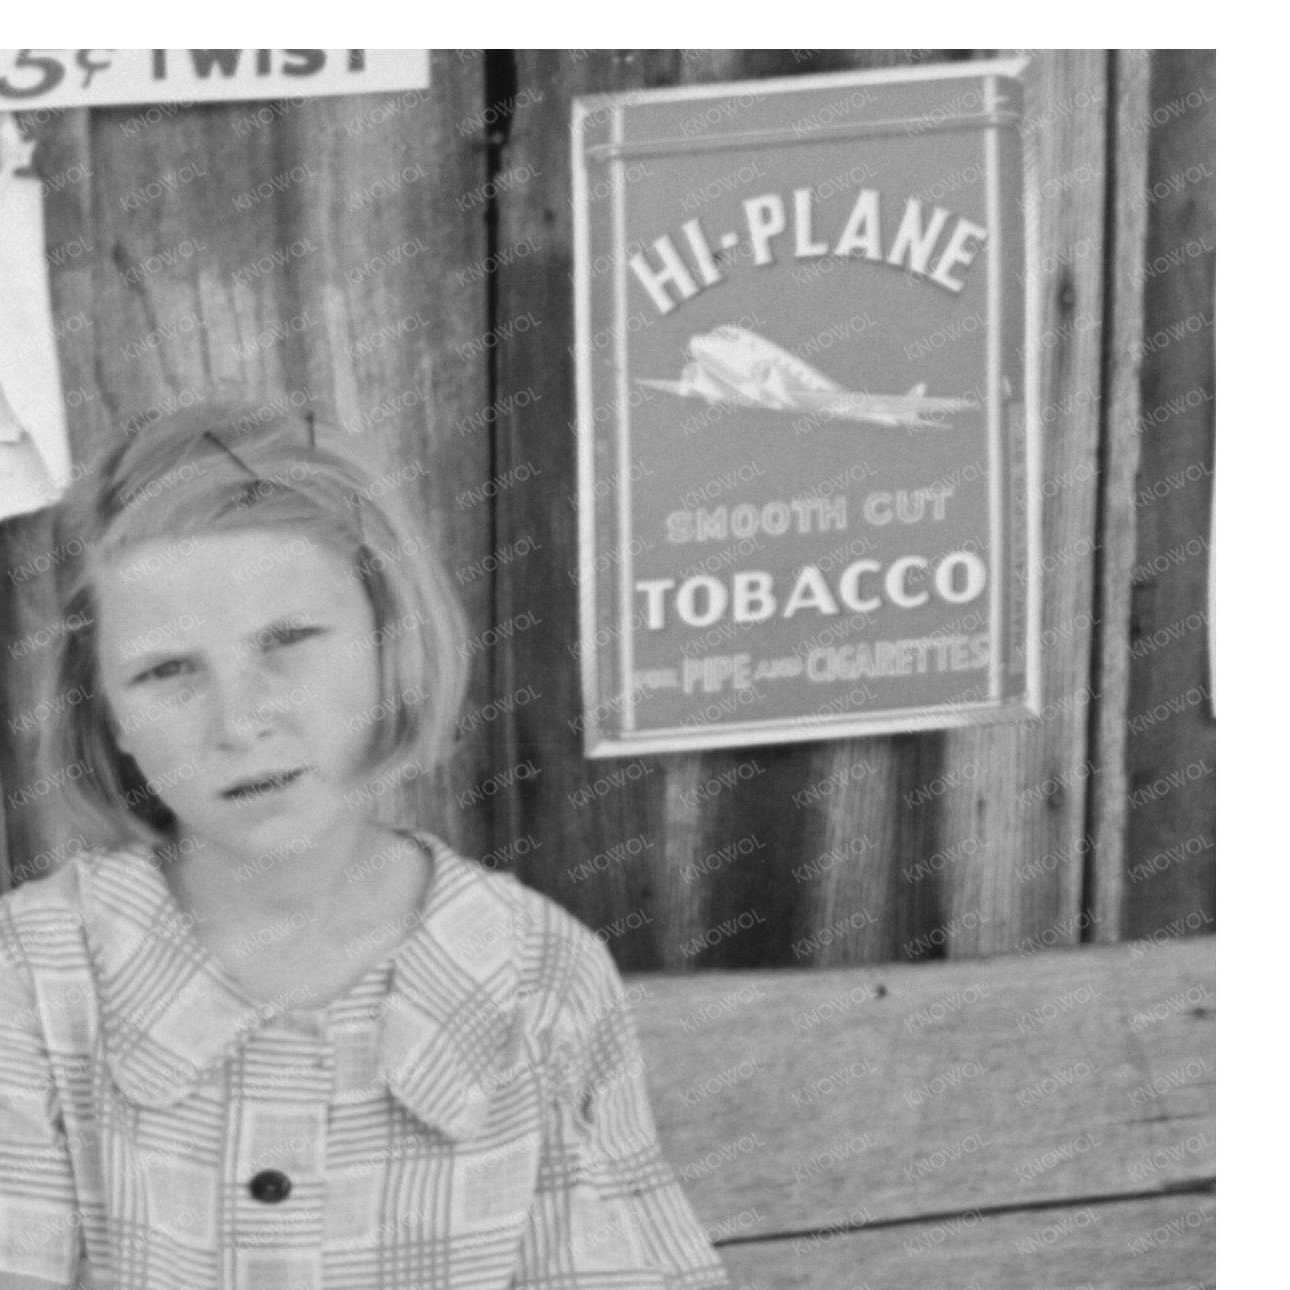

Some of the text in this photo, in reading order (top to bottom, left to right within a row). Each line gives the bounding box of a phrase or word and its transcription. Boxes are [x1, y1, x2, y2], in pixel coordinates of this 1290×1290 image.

[628, 187, 988, 315] HI-PLANE
[666, 487, 954, 543] SMOOTH CUT
[635, 550, 987, 631] TOBACCO
[682, 653, 753, 694] PIPE
[807, 633, 992, 683] CIGARETTES
